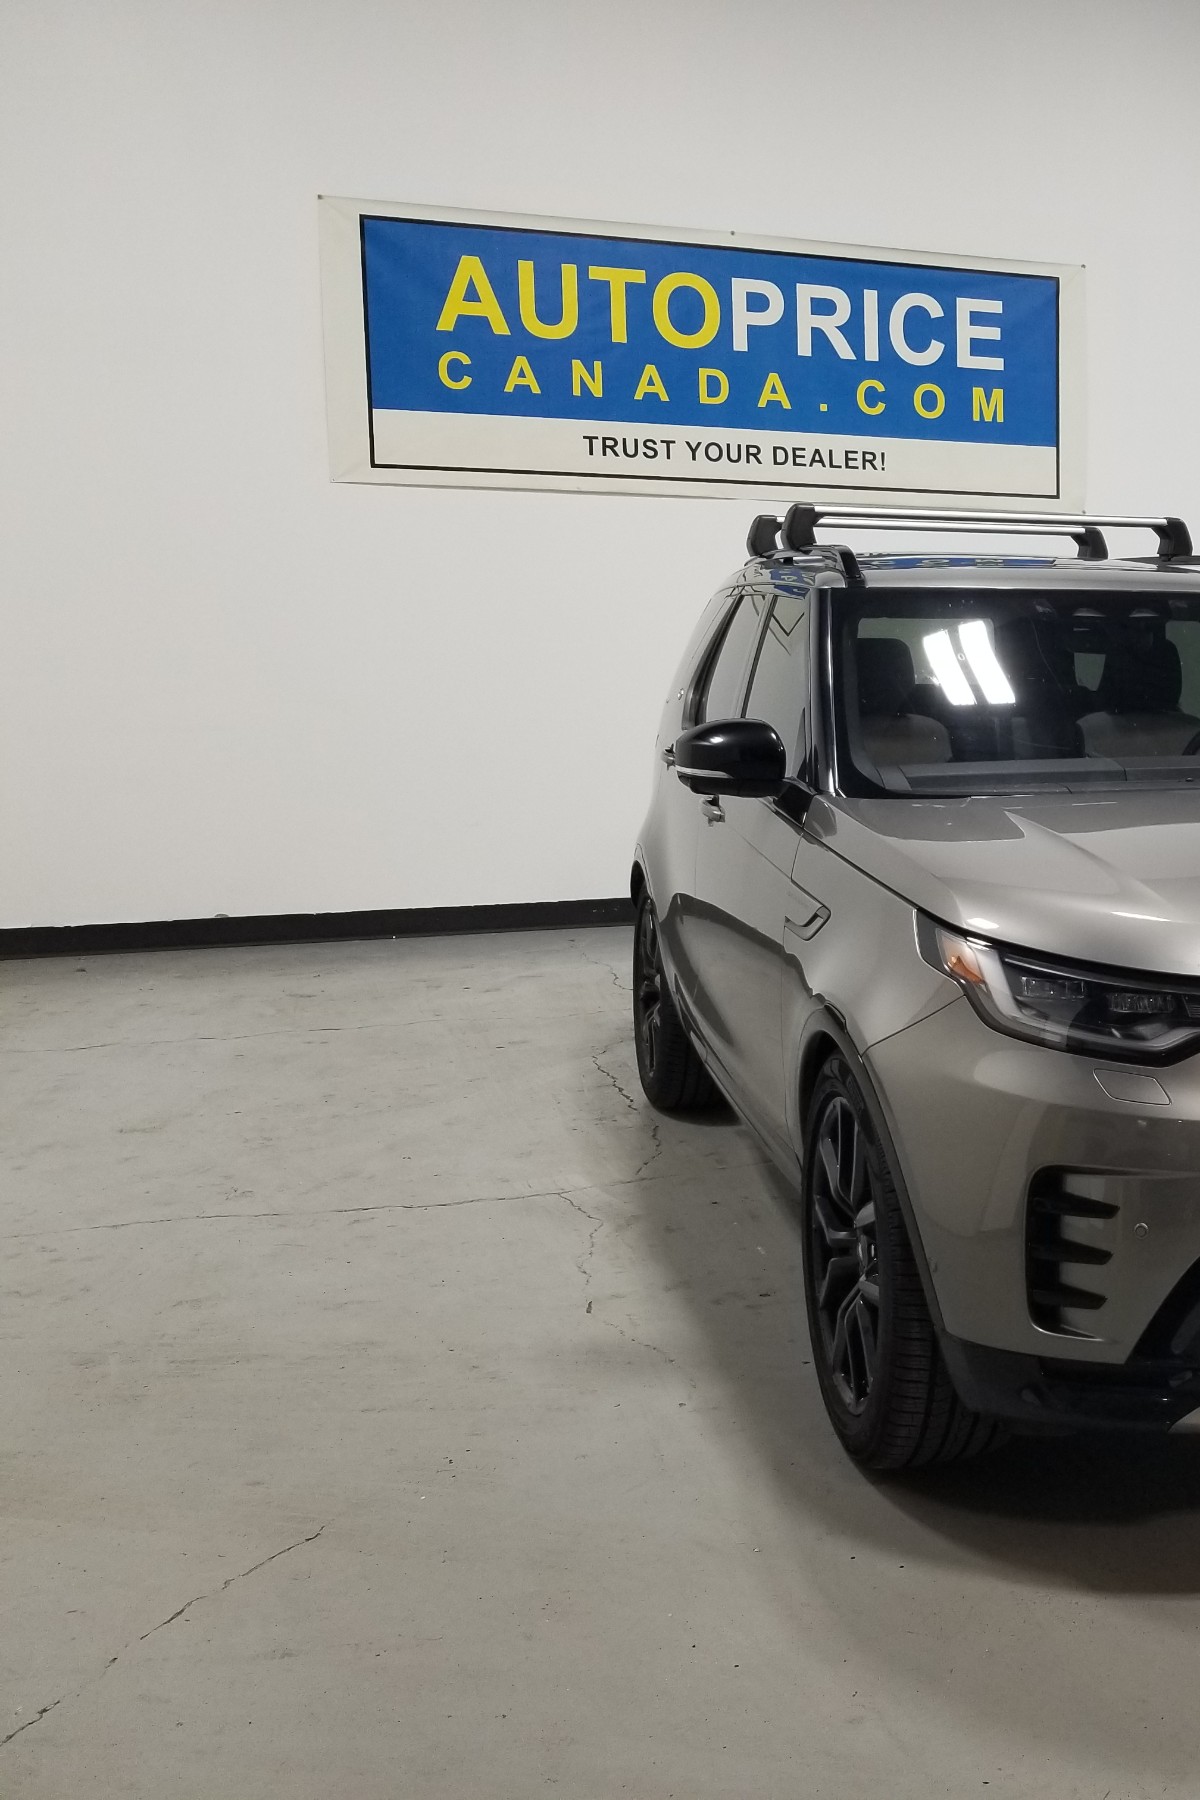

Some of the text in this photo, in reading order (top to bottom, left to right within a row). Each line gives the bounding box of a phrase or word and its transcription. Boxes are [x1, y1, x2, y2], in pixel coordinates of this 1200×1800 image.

[436, 255, 1005, 371] AUTOPRICE
[438, 351, 1004, 423] CANADA.COM
[582, 435, 886, 471] TRUST YOUR DEALER!
